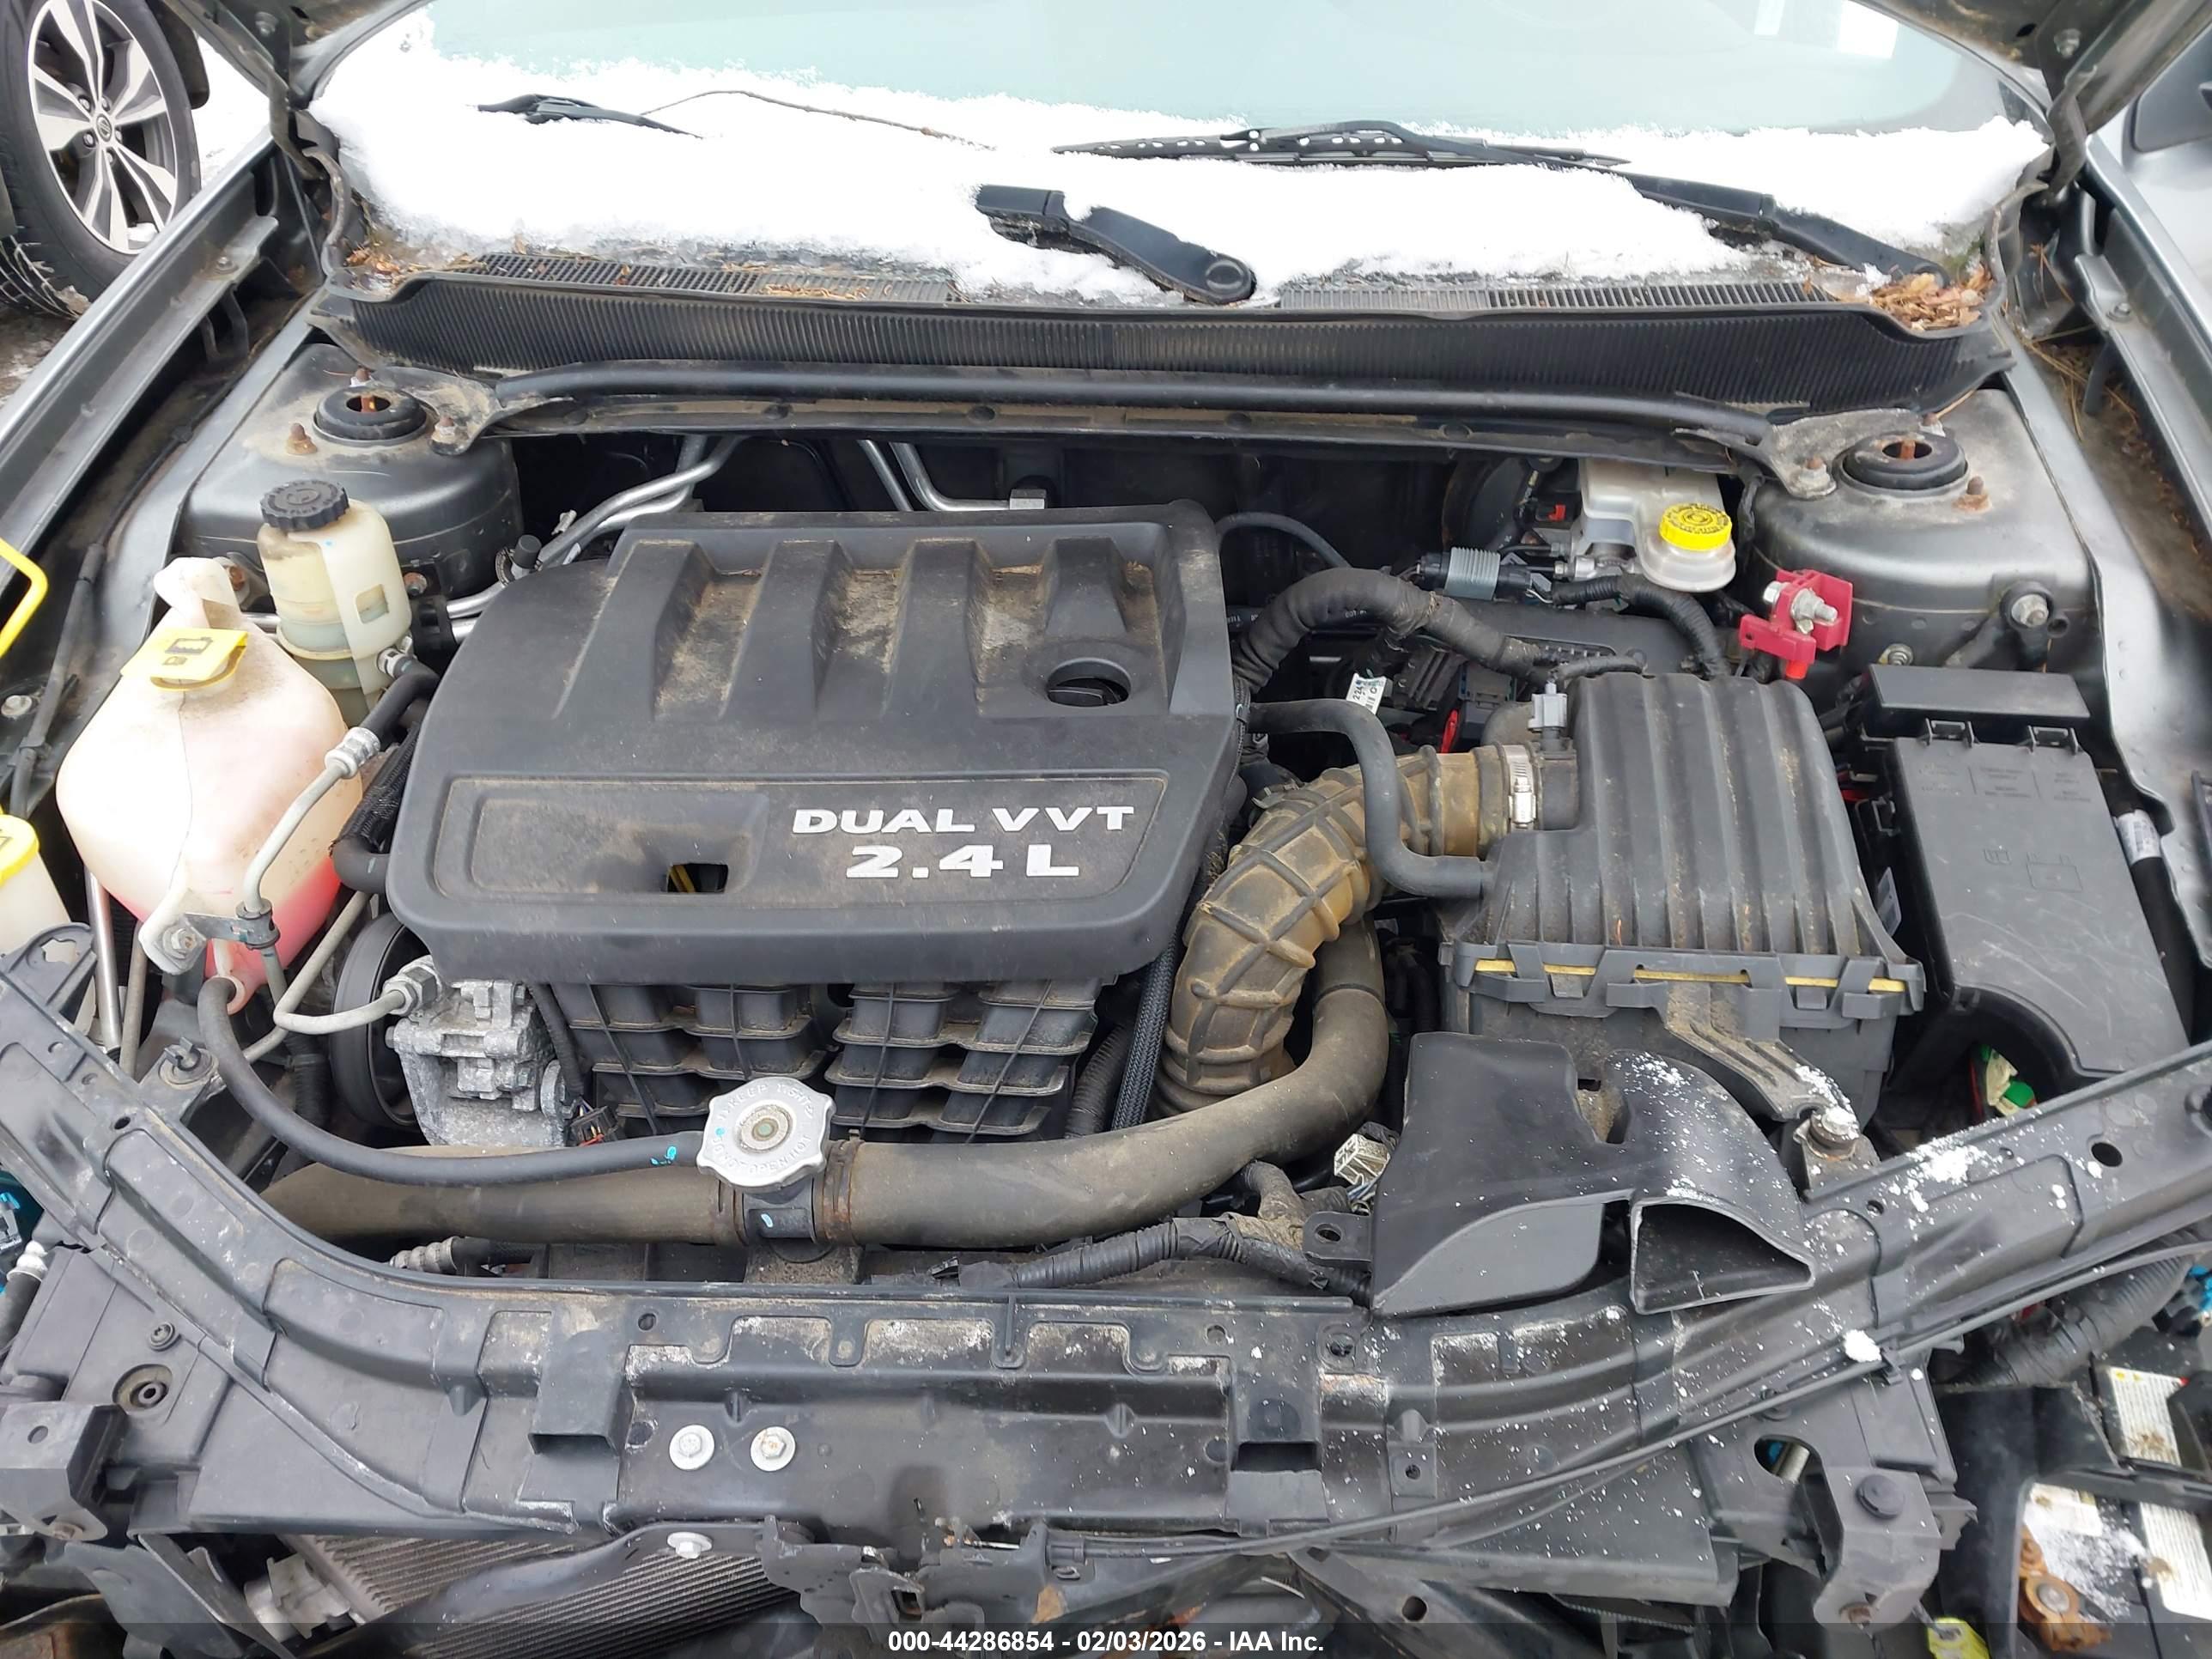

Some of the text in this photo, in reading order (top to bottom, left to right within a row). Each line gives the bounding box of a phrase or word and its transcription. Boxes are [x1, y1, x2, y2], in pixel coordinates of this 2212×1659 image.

[792, 805, 1134, 834] DUAL VVT
[729, 1085, 768, 1107] KEEP
[749, 1156, 790, 1175] OPEN
